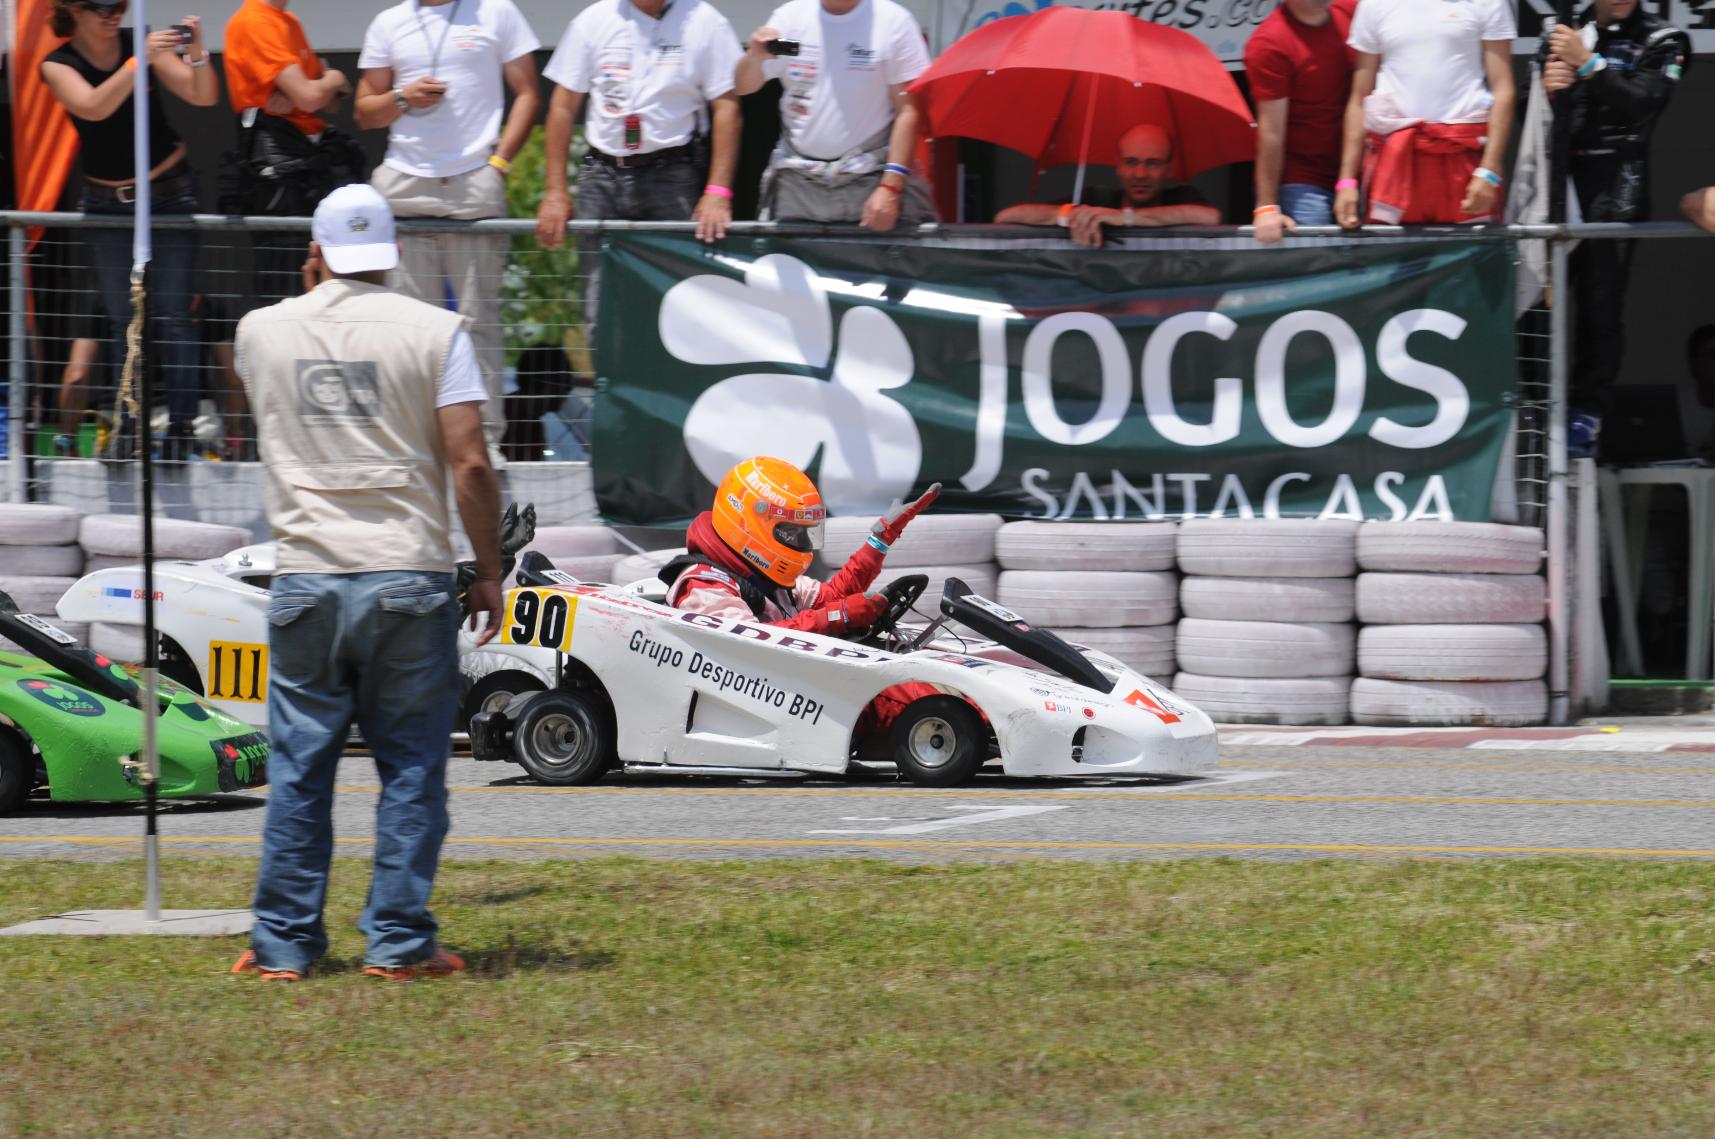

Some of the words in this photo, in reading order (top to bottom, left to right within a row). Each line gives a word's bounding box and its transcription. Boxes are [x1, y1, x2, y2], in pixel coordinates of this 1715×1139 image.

[960, 308, 1470, 492] JOGOS
[745, 470, 788, 507] Marlboro
[742, 546, 771, 570] Marlboro
[510, 590, 568, 650] 90
[209, 645, 263, 701] 111
[629, 629, 684, 668] Grupo
[687, 651, 786, 708] Desportivo
[788, 692, 825, 726] BPI
